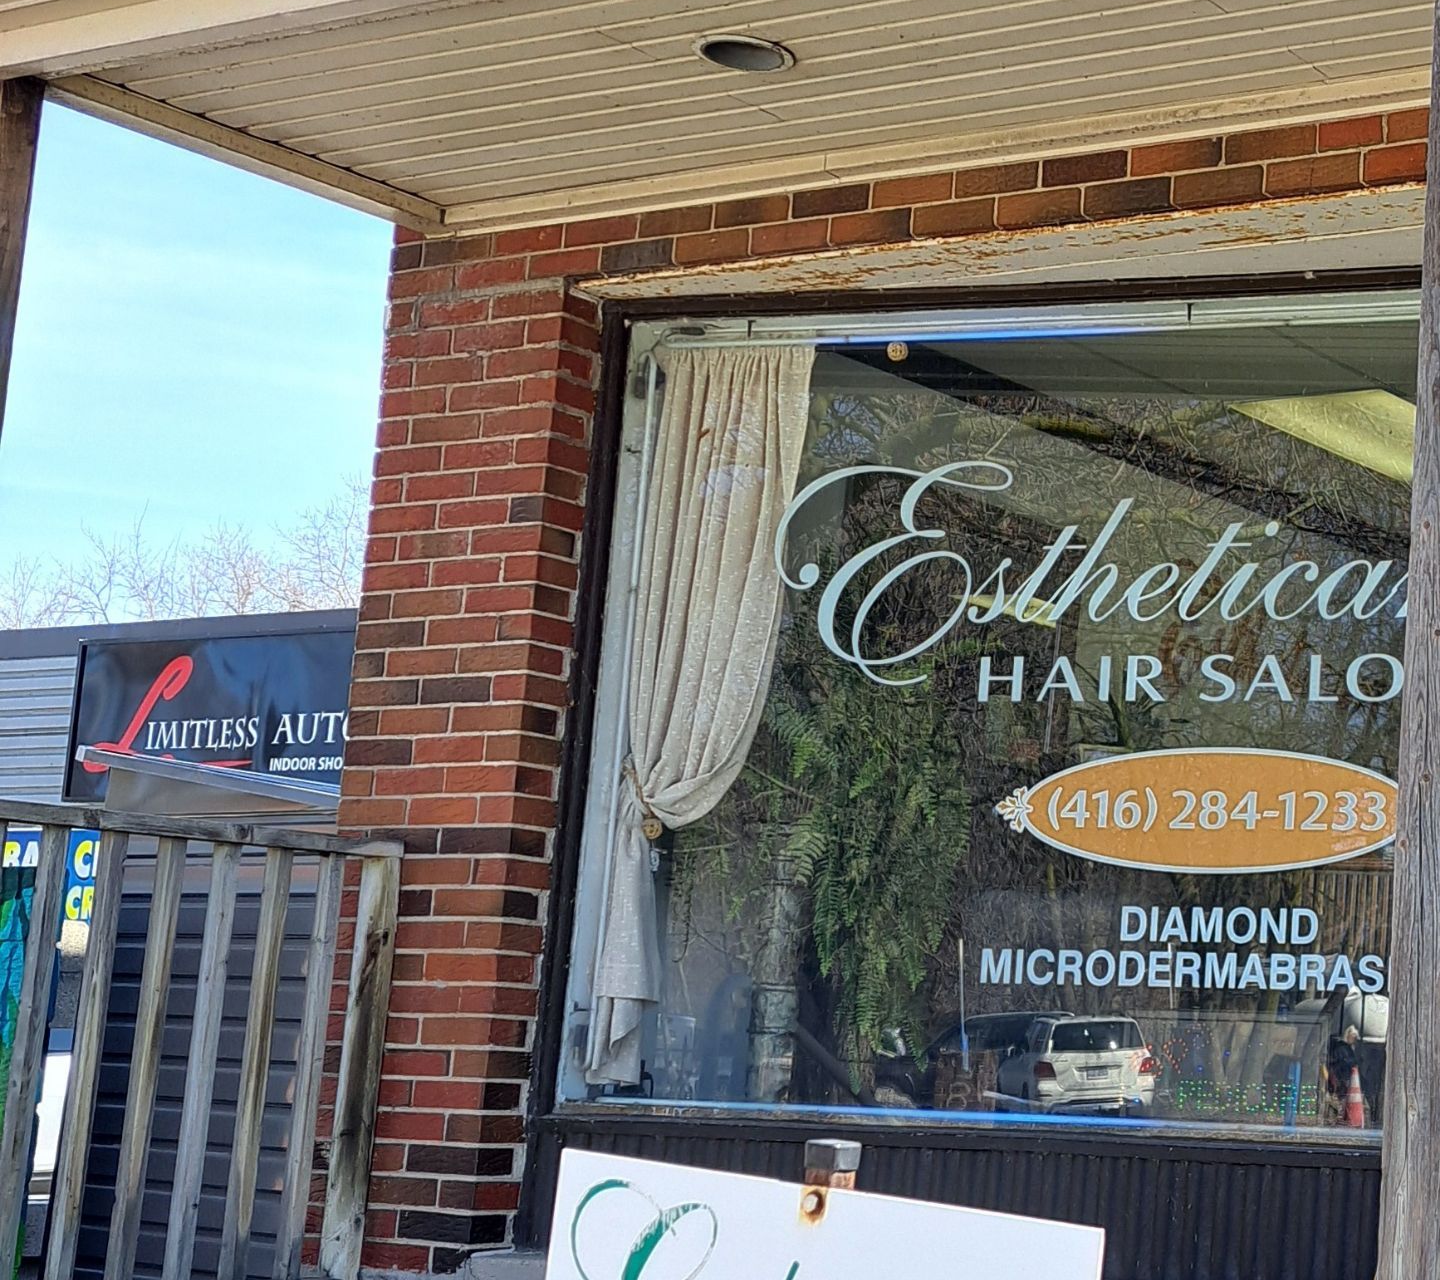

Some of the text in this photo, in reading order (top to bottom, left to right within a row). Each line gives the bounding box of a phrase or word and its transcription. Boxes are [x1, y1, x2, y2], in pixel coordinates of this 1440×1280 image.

[978, 652, 1405, 703] HAIR SALO
[84, 655, 259, 772] LIMITLESS
[270, 756, 316, 771] INDOOR
[1047, 786, 1387, 834] (416) 284-1233
[1119, 906, 1318, 945] DIAMOND
[980, 948, 1391, 994] MICRODERMABRAS
